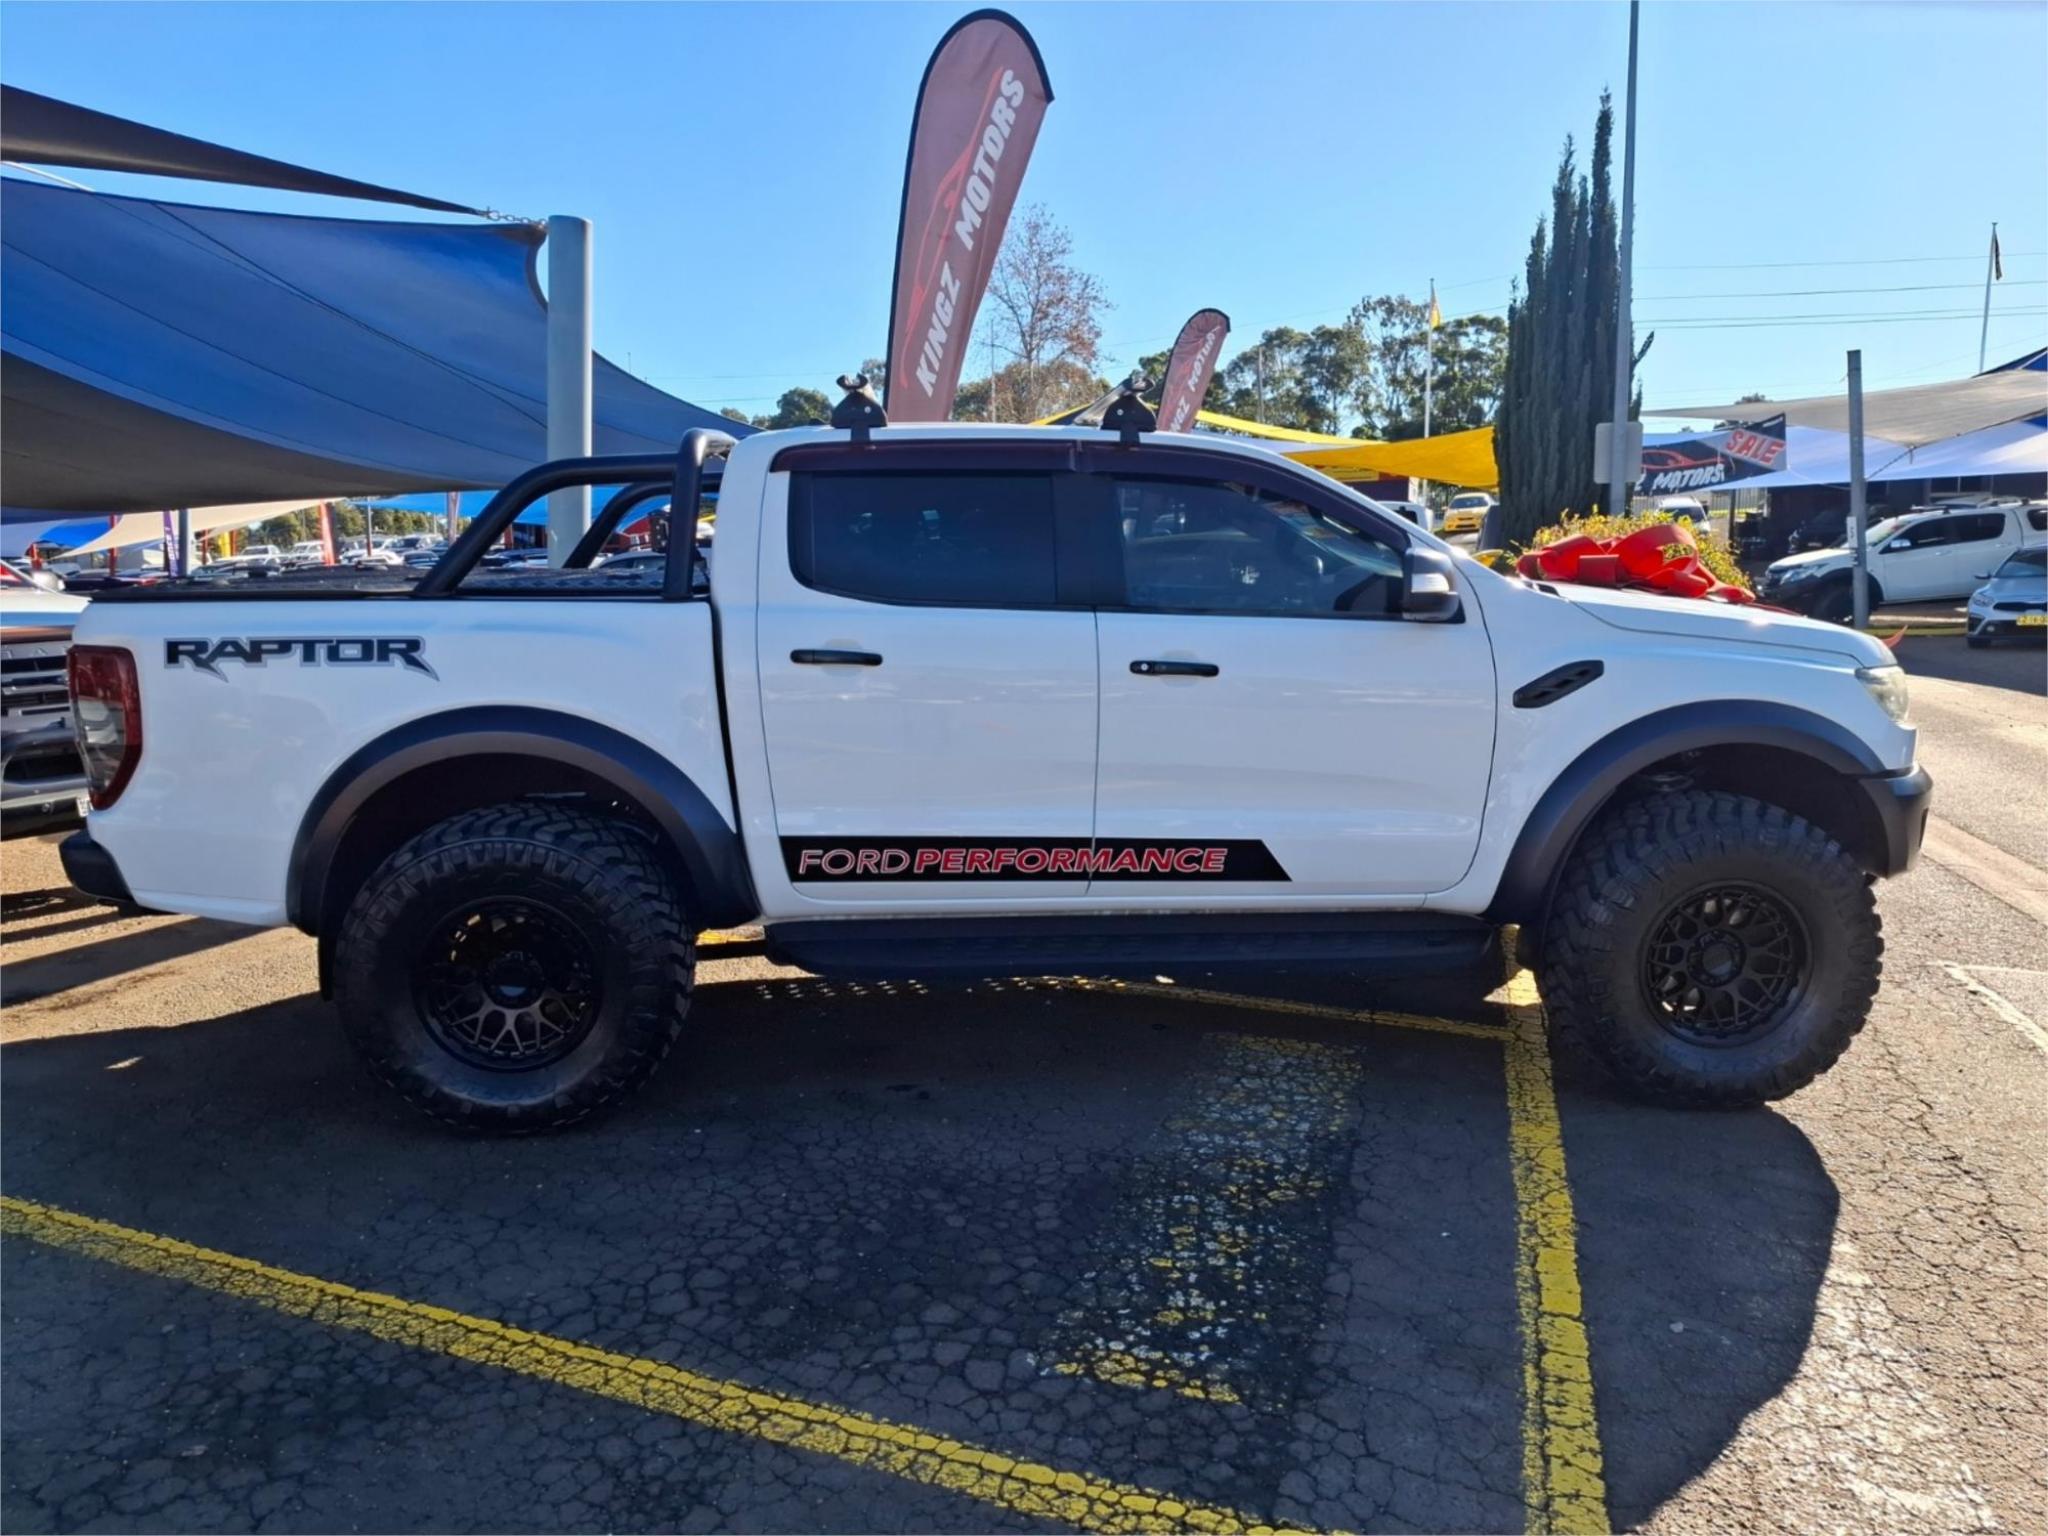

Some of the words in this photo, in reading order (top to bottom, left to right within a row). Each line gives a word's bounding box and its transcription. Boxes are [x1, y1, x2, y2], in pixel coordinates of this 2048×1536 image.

[916, 262, 961, 398] KINGZ
[955, 69, 1025, 251] MOTORS
[1169, 396, 1190, 432] NGZ
[1726, 428, 1786, 465] SALE
[1651, 464, 1726, 493] MOTORS
[164, 636, 440, 683] RAPTOR
[799, 849, 910, 874] FORD
[913, 848, 1228, 873] PERFORMANCE
